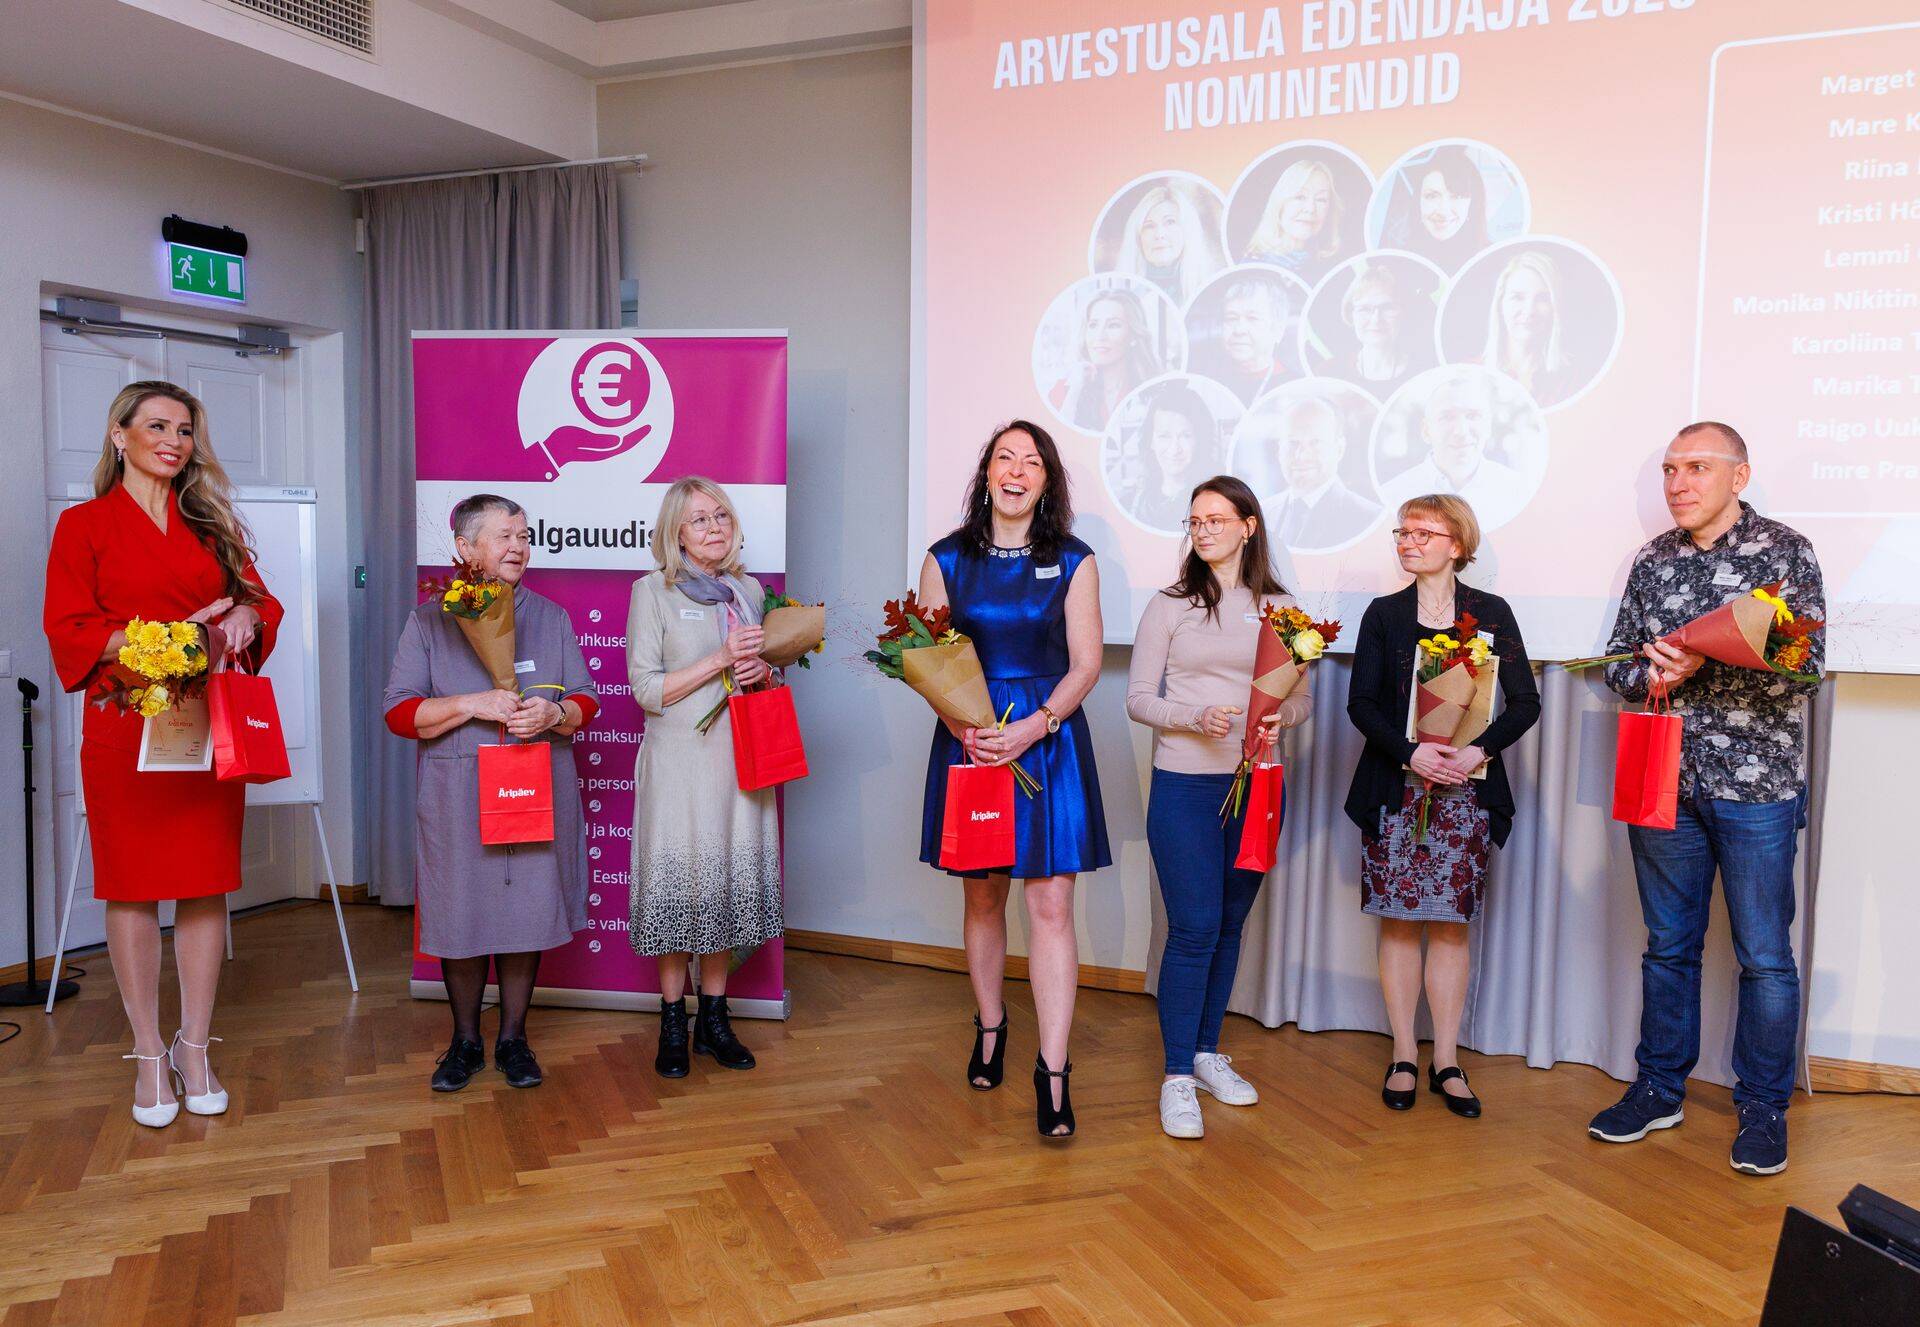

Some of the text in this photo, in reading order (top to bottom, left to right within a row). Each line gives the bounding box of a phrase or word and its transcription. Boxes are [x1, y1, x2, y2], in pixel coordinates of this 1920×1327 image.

[993, 0, 1549, 89] ARVESTUSALA EDENDAJA
[1164, 52, 1460, 131] NOMINENDID
[1821, 69, 1916, 96] Marget
[1828, 118, 1898, 138] Mare
[1845, 158, 1909, 180] Riina
[1818, 202, 1882, 225] Kristi
[1824, 243, 1911, 269] Lemmi
[1733, 294, 1826, 315] Monika
[1792, 332, 1904, 355] Karoliina
[1812, 375, 1901, 396] Marika
[1797, 418, 1869, 442] Raigo
[1812, 461, 1870, 480] Imre
[498, 787, 536, 799] Äripäev
